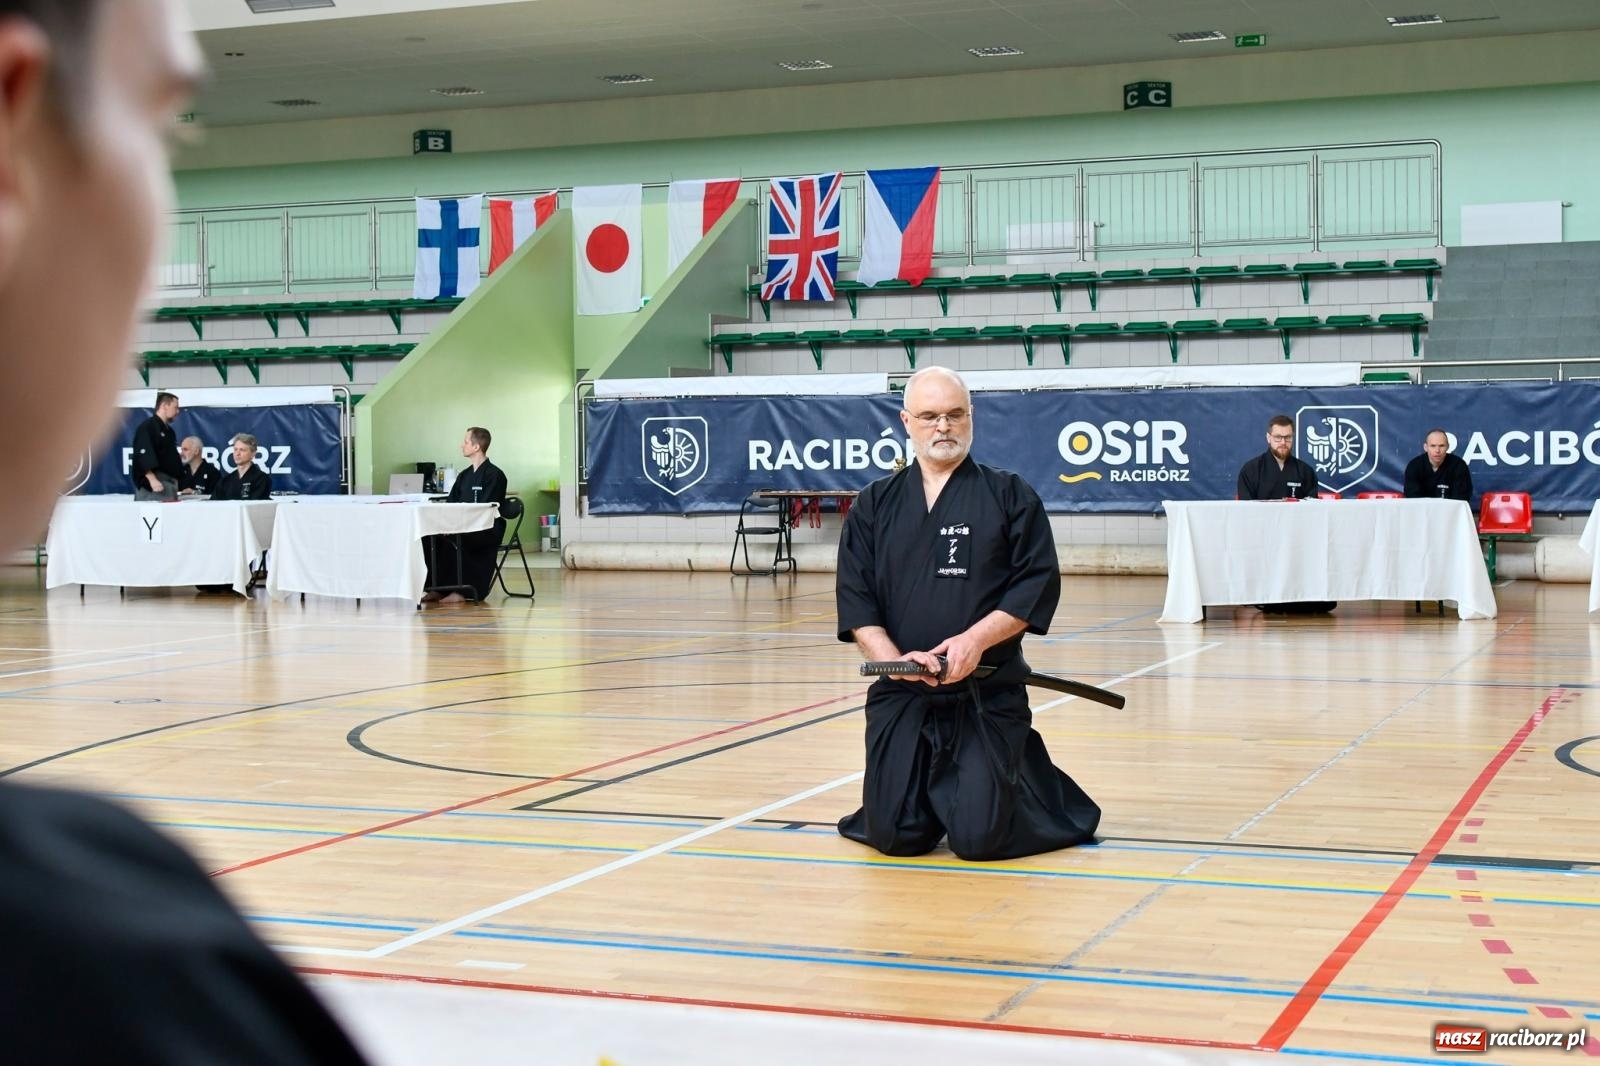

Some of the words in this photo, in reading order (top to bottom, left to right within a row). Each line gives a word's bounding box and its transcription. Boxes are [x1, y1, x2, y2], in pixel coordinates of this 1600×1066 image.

[1126, 91, 1138, 105] C
[1148, 90, 1166, 104] C
[428, 137, 444, 150] B
[748, 427, 917, 471] RACIBÓ
[1110, 466, 1190, 482] RACIBÓRZ
[142, 516, 159, 541] Y
